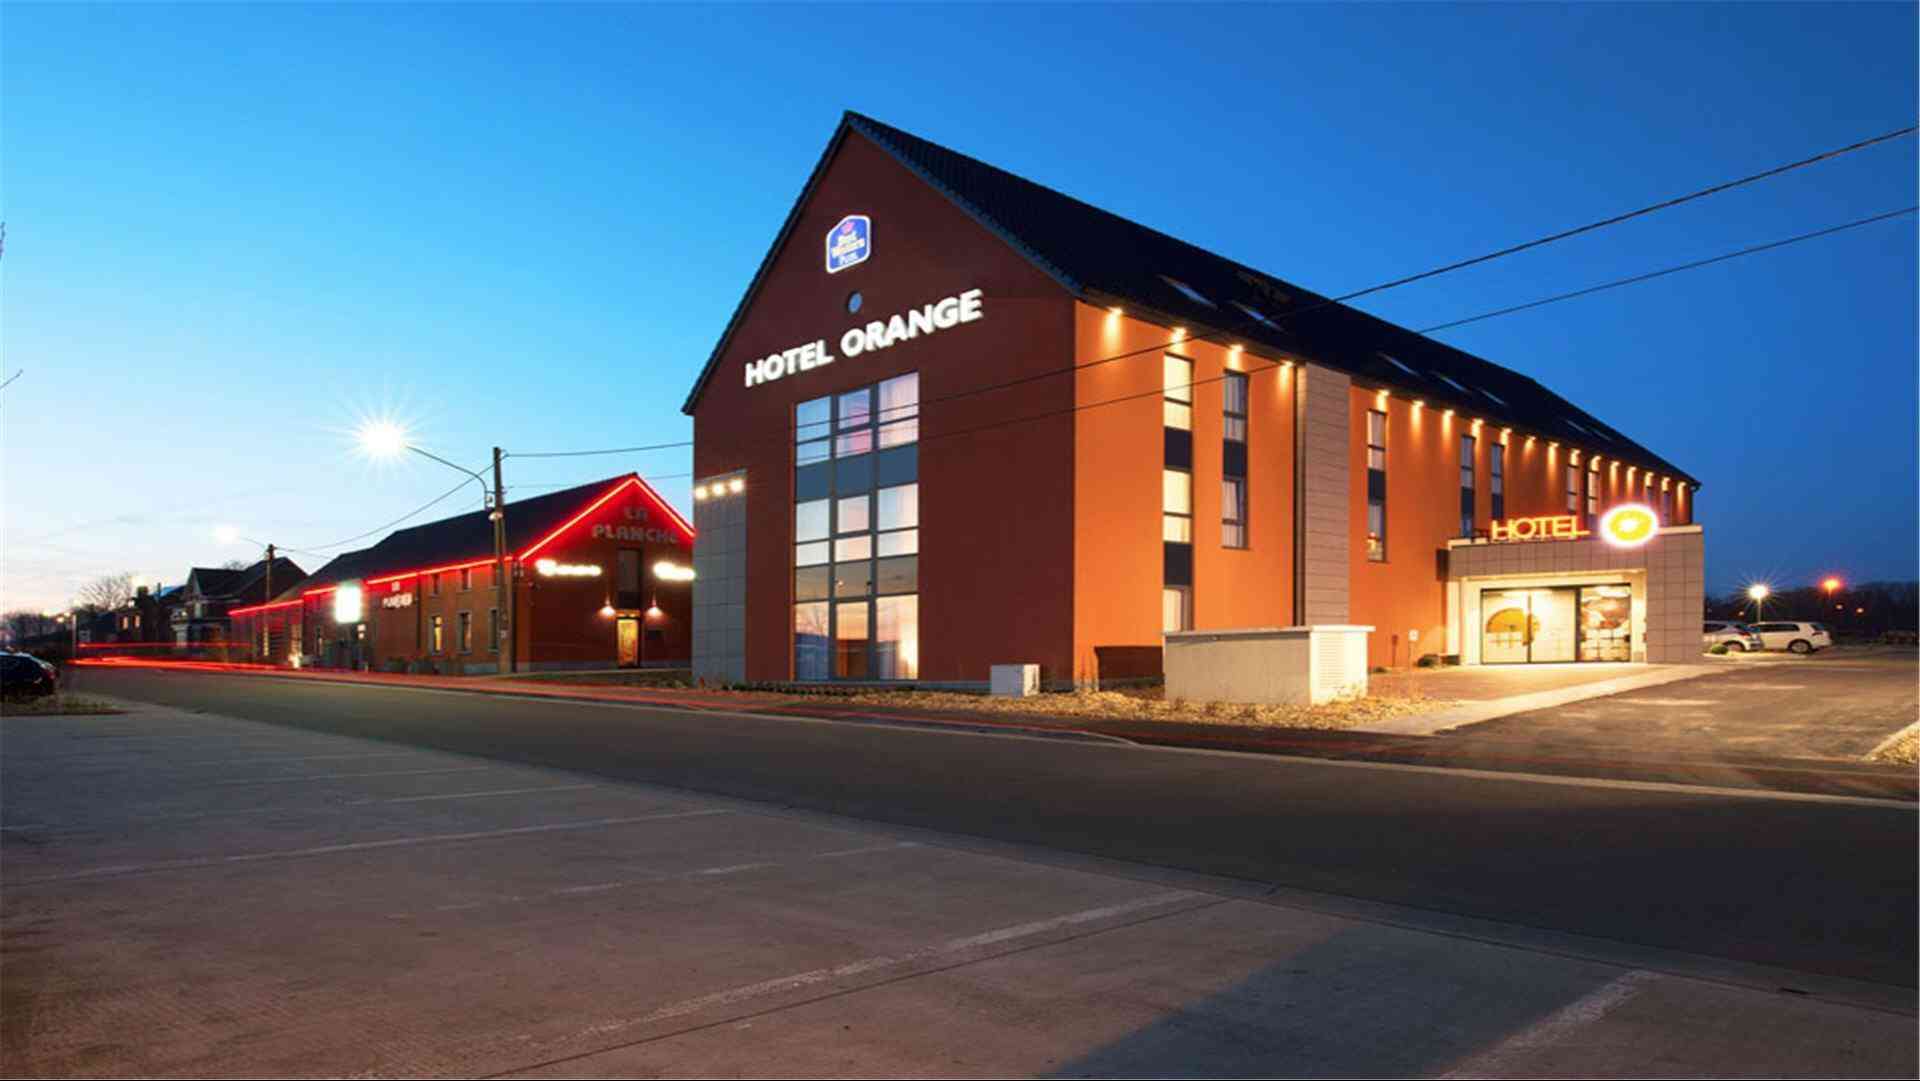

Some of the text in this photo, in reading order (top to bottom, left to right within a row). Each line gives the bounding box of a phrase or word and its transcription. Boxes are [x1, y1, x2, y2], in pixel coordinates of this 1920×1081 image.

[744, 289, 983, 388] HOTEL ORANGE
[1492, 515, 1591, 541] HOTEL
